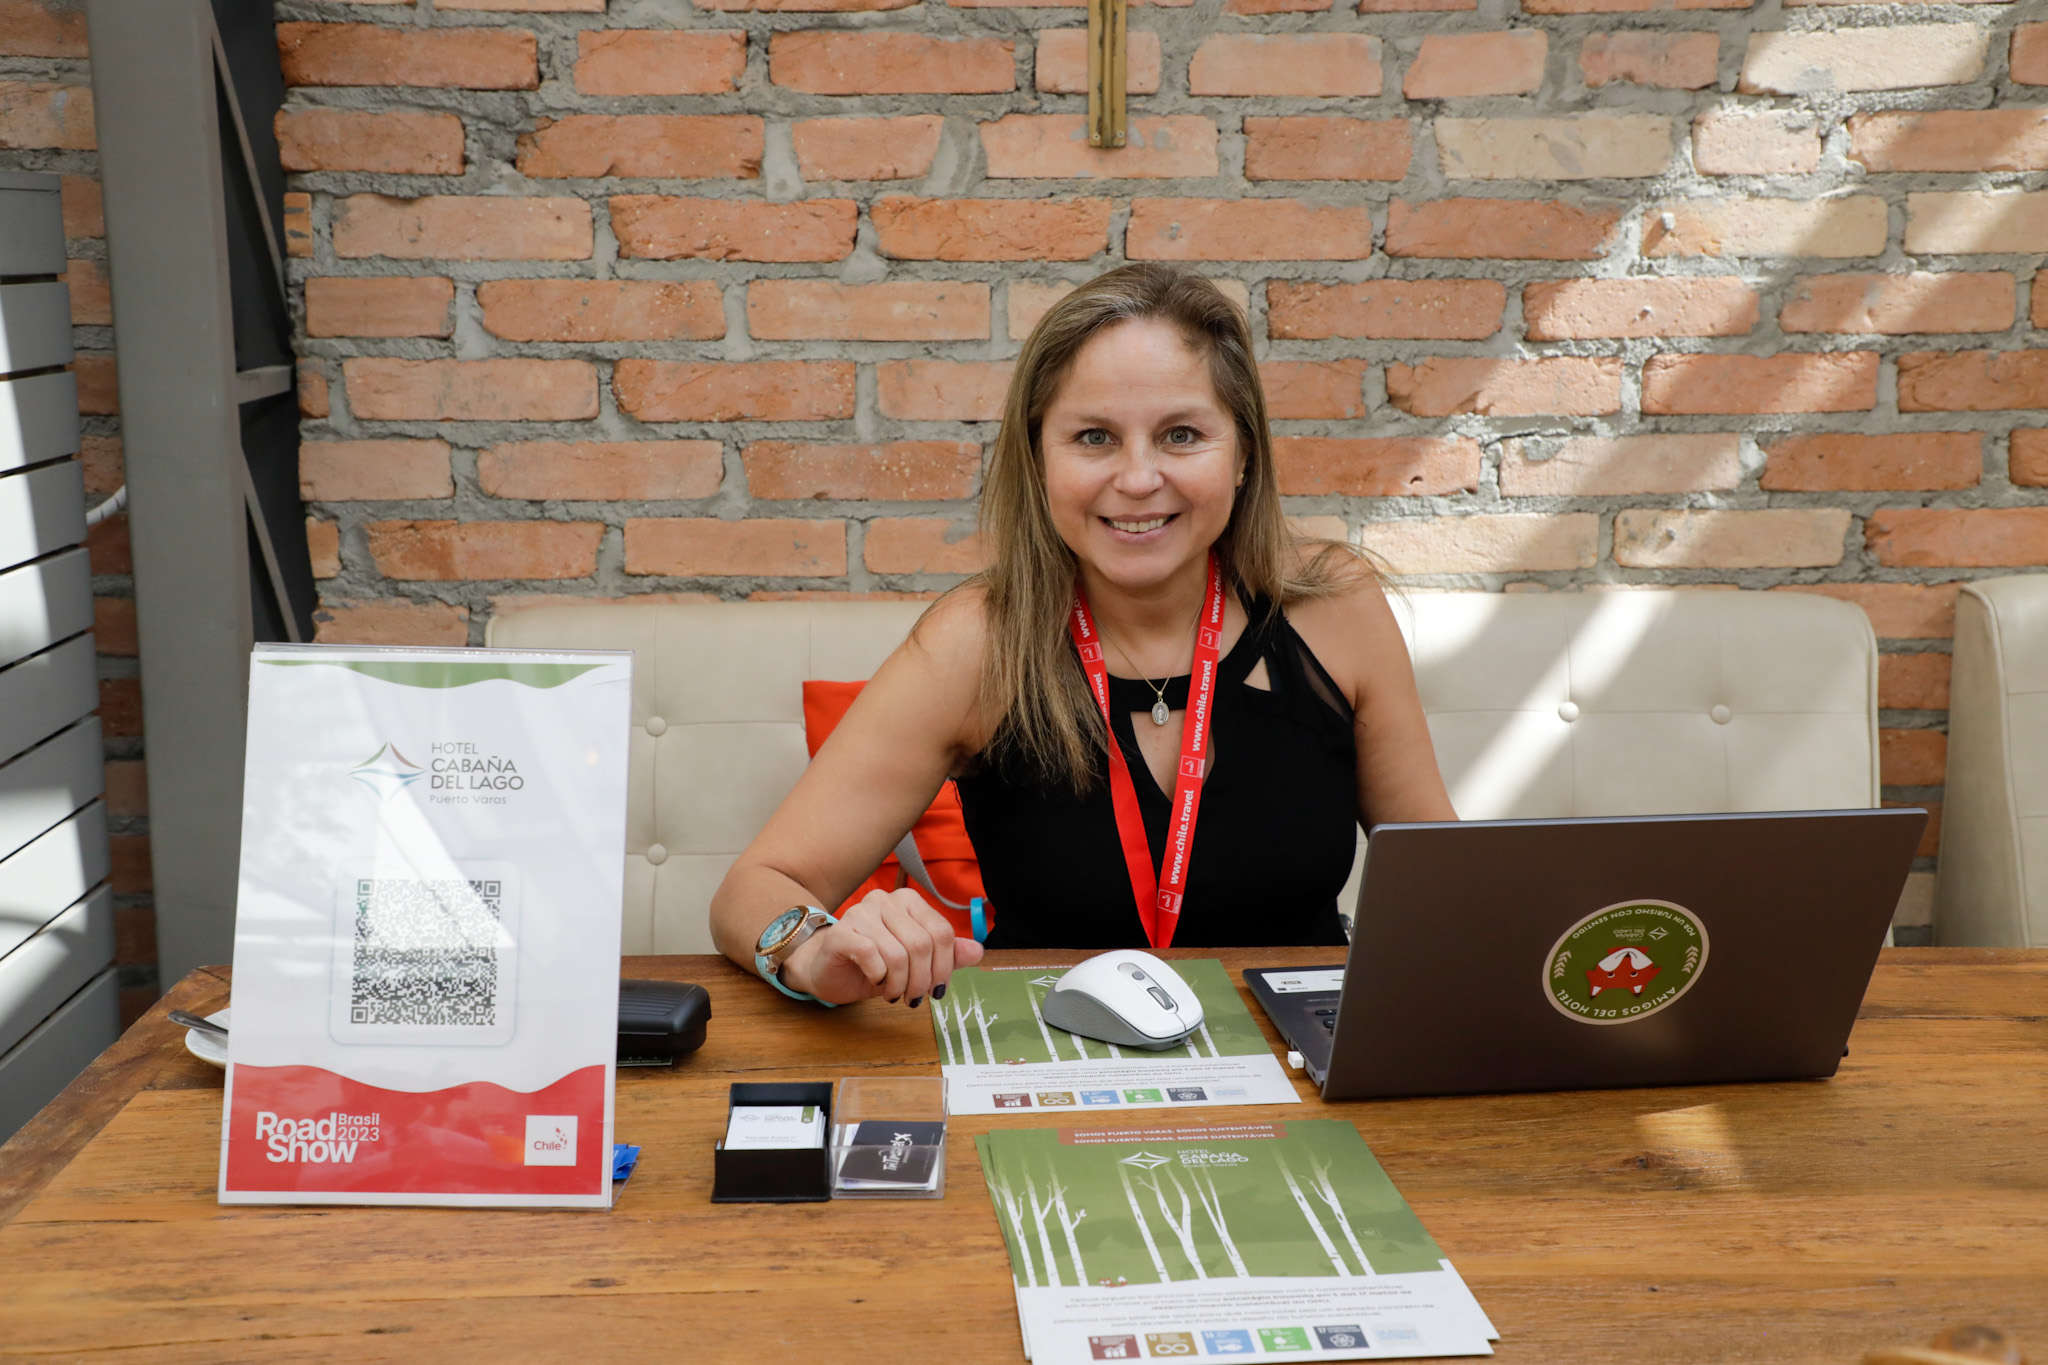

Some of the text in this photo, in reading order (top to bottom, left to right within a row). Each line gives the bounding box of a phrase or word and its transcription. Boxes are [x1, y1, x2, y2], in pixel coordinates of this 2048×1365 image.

[1192, 660, 1212, 752] www.chile.travel
[431, 742, 479, 755] HOTEL
[431, 756, 517, 774] CABAÑA
[431, 775, 524, 790] DEL LAGO
[429, 794, 507, 805] Puerto Varas
[1170, 790, 1194, 885] www.chile.travel
[1572, 908, 1697, 939] POR UN TURISMO CON SENTIDO
[1556, 986, 1677, 1018] AMIGOS DEL HOTEL
[338, 1112, 379, 1126] Brasil
[255, 1111, 358, 1163] Road Show
[337, 1126, 380, 1142] 2023
[533, 1140, 562, 1151] Chile
[1179, 1151, 1241, 1160] CABAÑA
